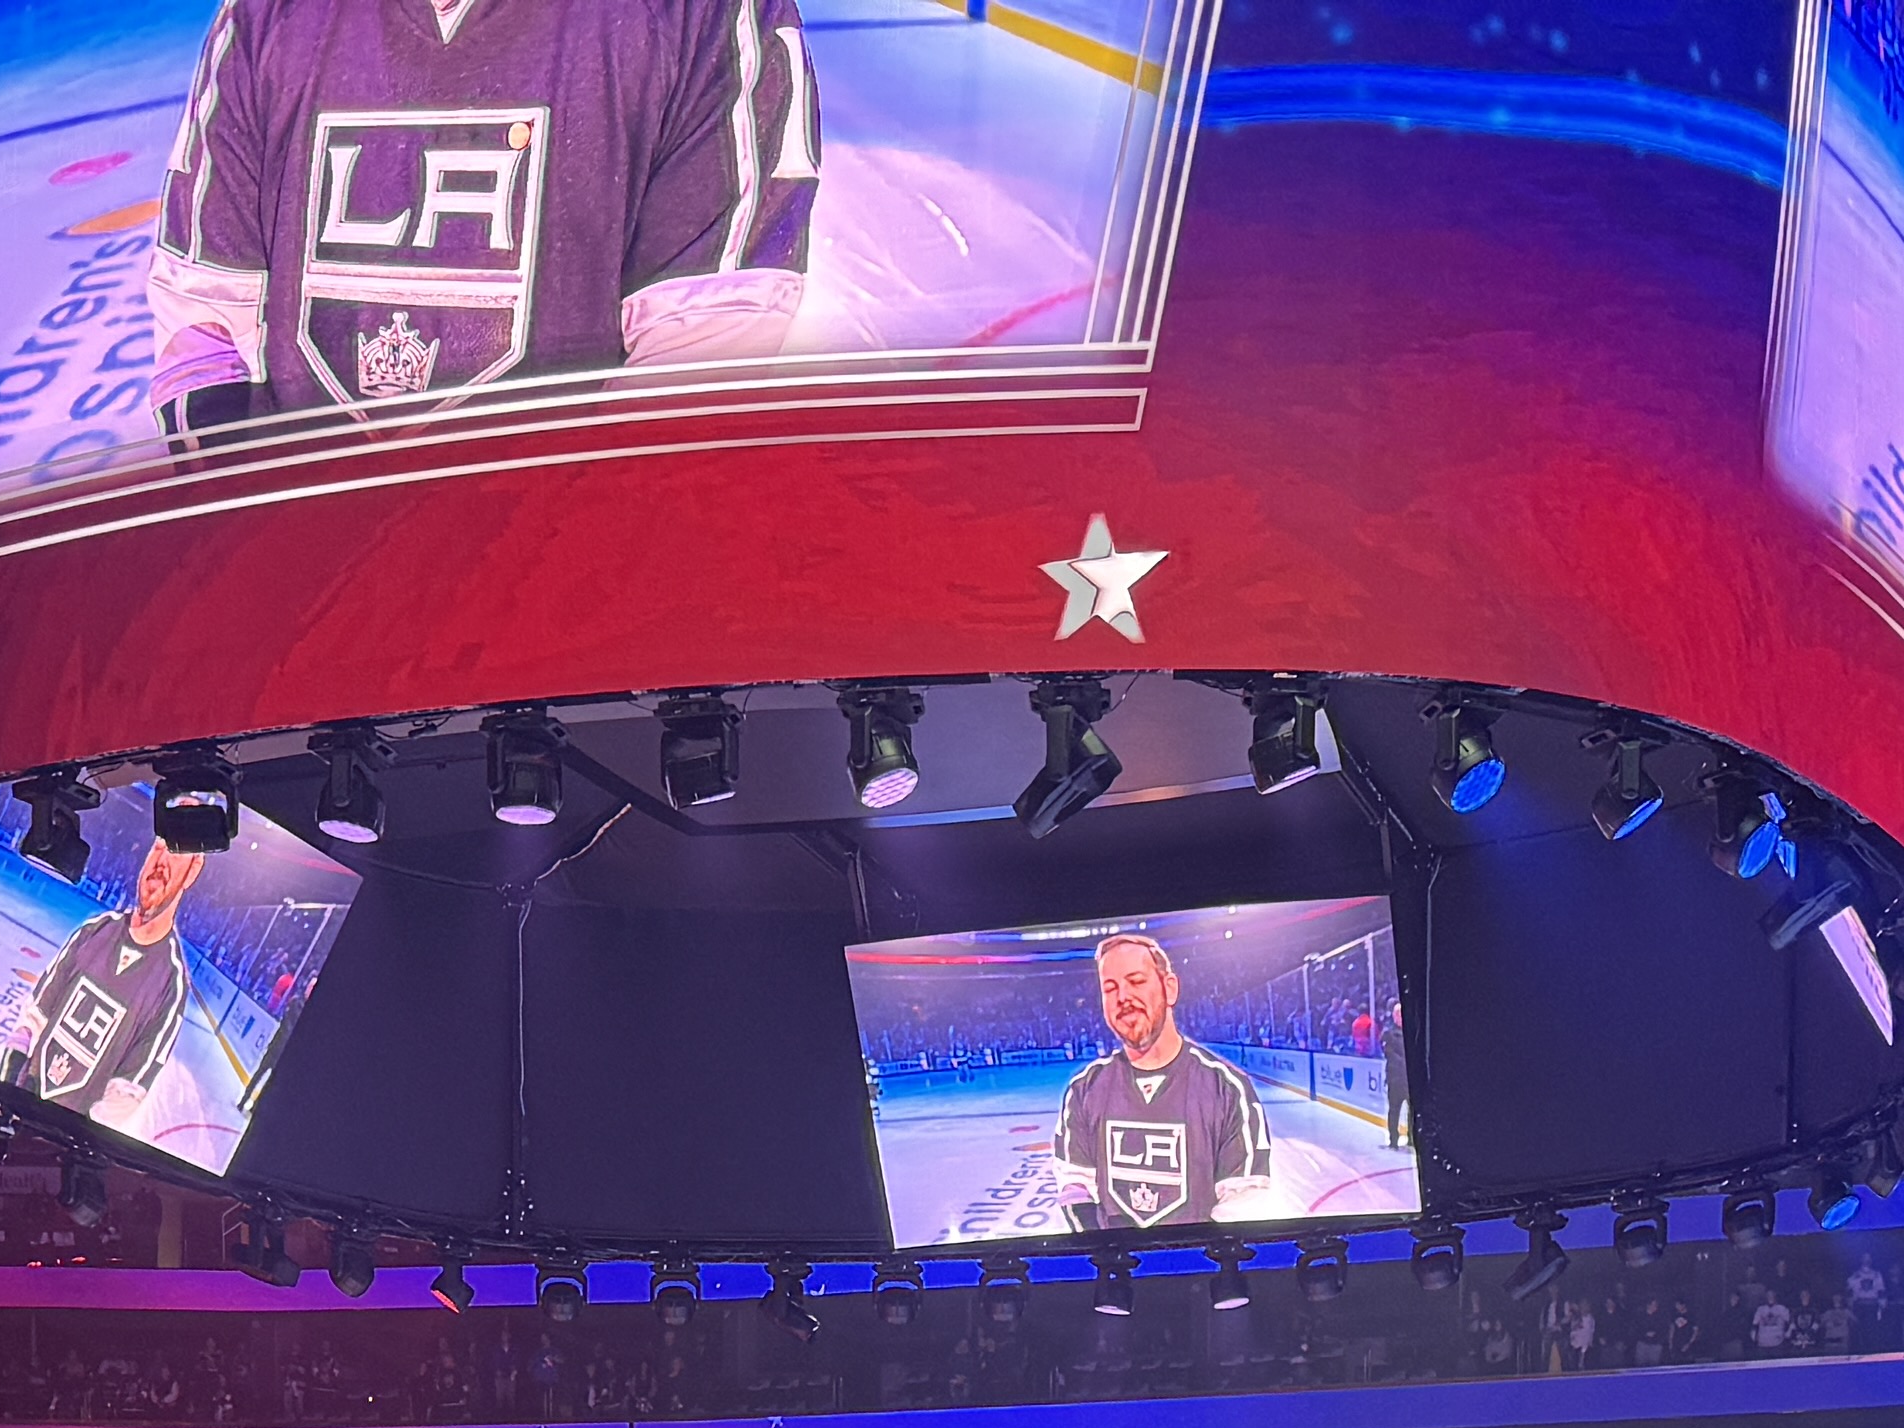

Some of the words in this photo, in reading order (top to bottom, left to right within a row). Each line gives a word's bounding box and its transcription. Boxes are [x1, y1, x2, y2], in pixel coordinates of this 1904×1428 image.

[322, 144, 521, 248] LA
[62, 990, 109, 1050] LA
[1112, 1130, 1180, 1169] LA
